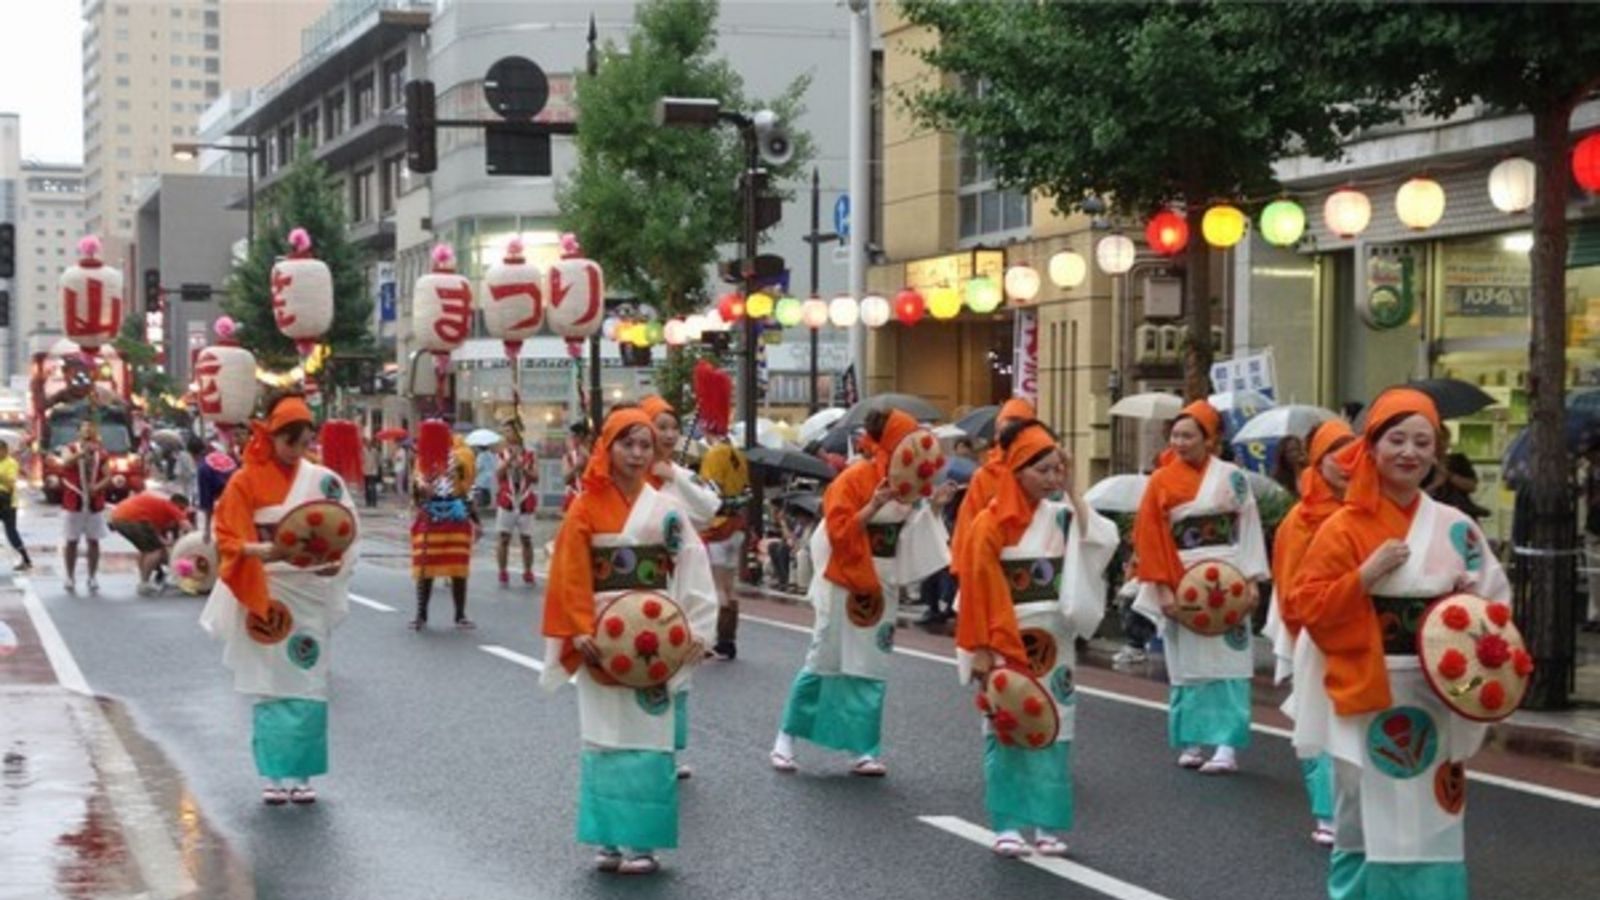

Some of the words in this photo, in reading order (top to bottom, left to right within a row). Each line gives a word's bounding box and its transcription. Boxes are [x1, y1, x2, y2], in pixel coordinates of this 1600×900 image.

[63, 278, 122, 338] 山
[433, 282, 473, 344] ま
[489, 282, 544, 330] つ
[549, 264, 602, 326] り
